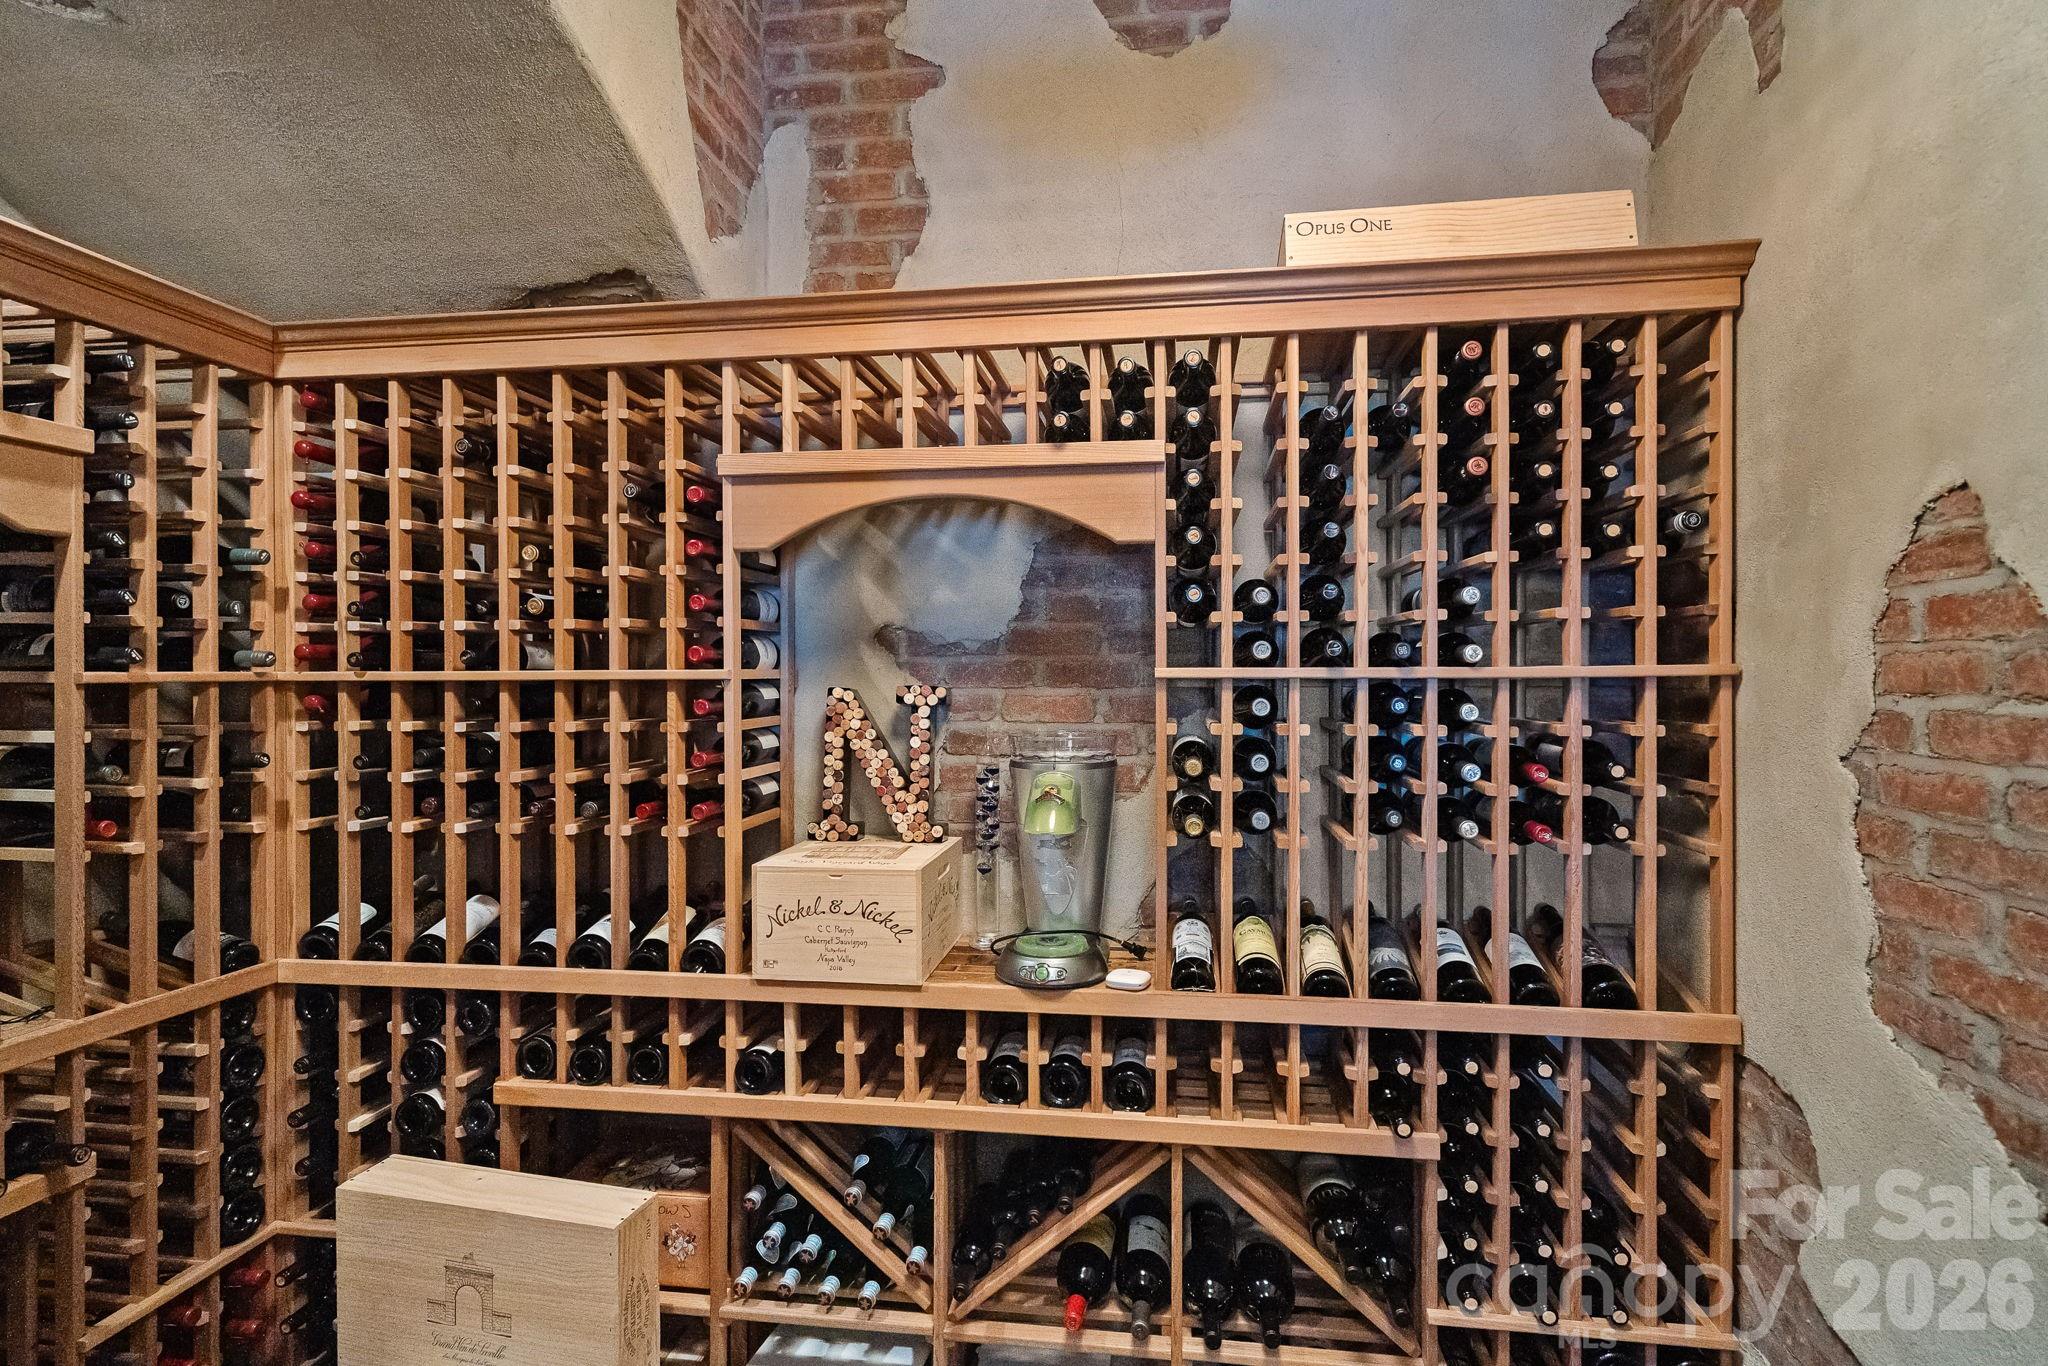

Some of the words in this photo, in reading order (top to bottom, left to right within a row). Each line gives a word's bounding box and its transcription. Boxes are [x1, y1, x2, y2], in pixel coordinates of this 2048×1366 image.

[766, 895, 825, 938] Nickel
[829, 899, 843, 914] &
[844, 899, 914, 944] Nickel
[834, 925, 855, 937] Ranch
[804, 935, 835, 946] Cabernet
[835, 936, 868, 949] Sauvignon
[817, 952, 835, 966] Napa
[836, 954, 856, 967] Valley
